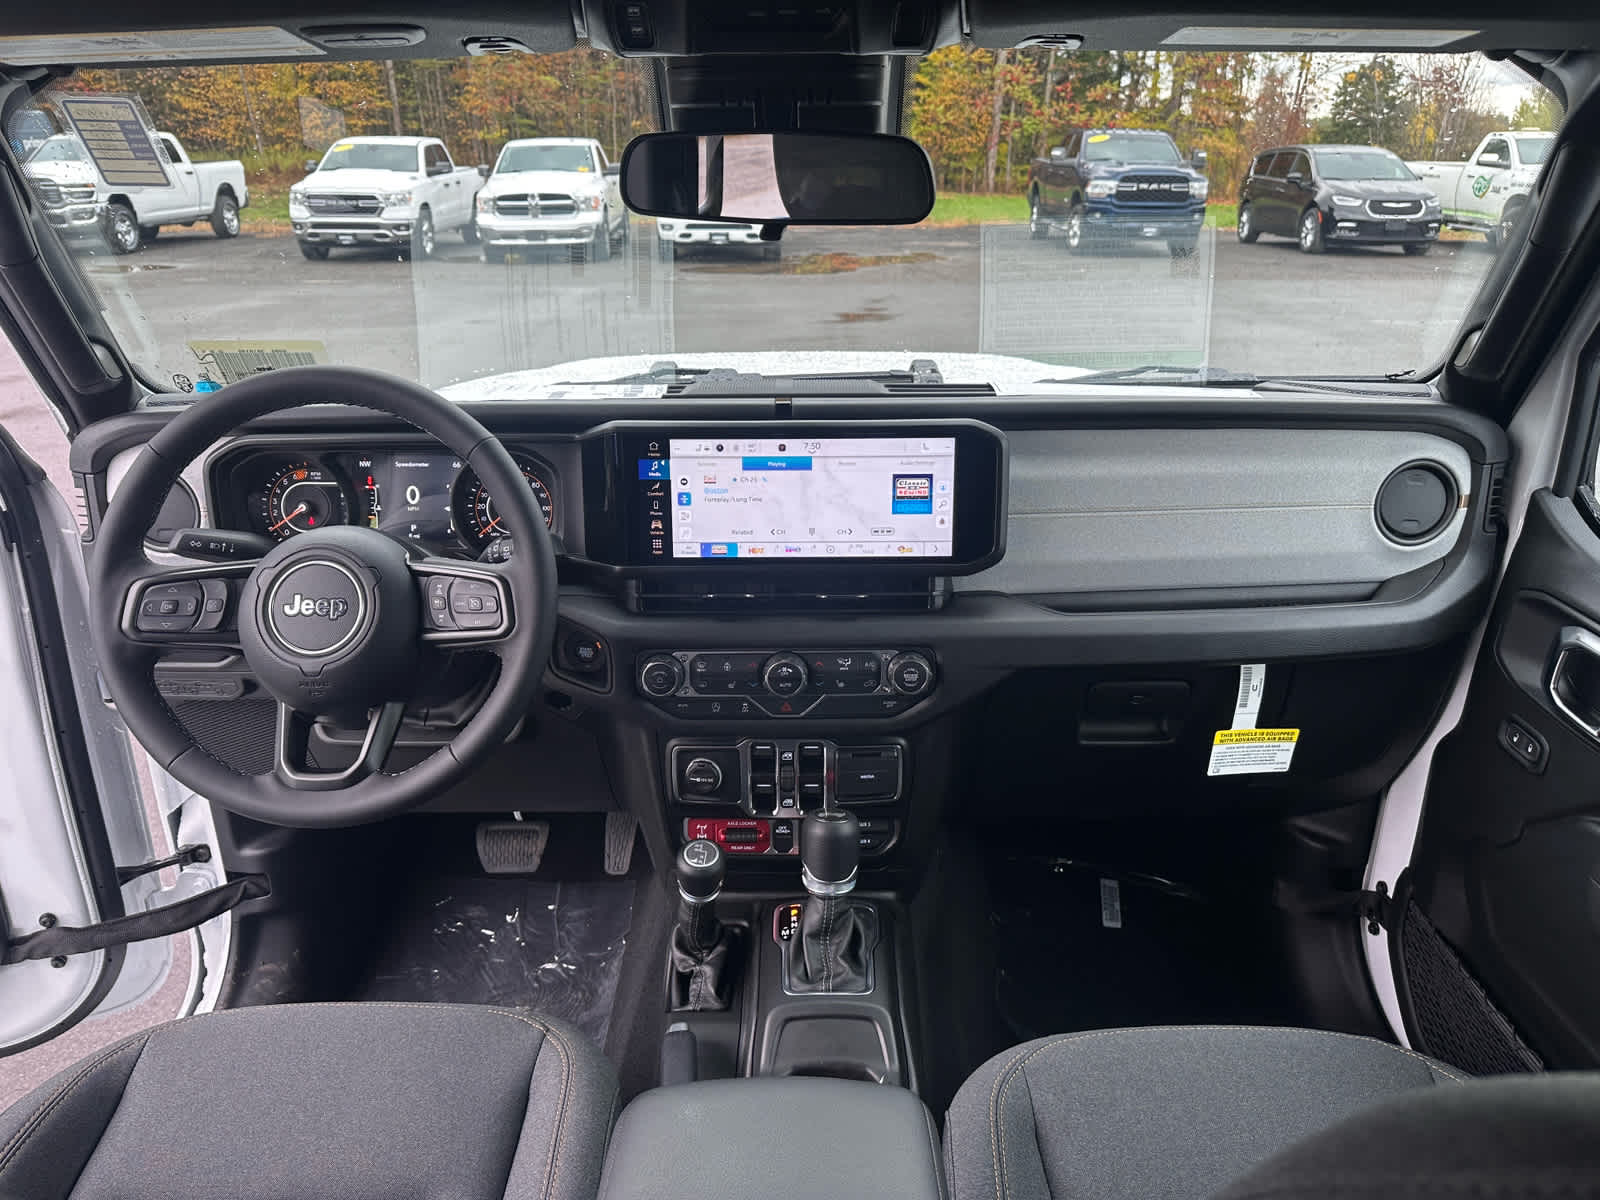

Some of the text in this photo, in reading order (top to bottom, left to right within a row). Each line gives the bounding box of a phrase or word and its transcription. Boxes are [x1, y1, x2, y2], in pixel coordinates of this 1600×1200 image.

[804, 441, 821, 450] 7:50
[406, 485, 420, 505] 0
[283, 593, 348, 620] Jeep
